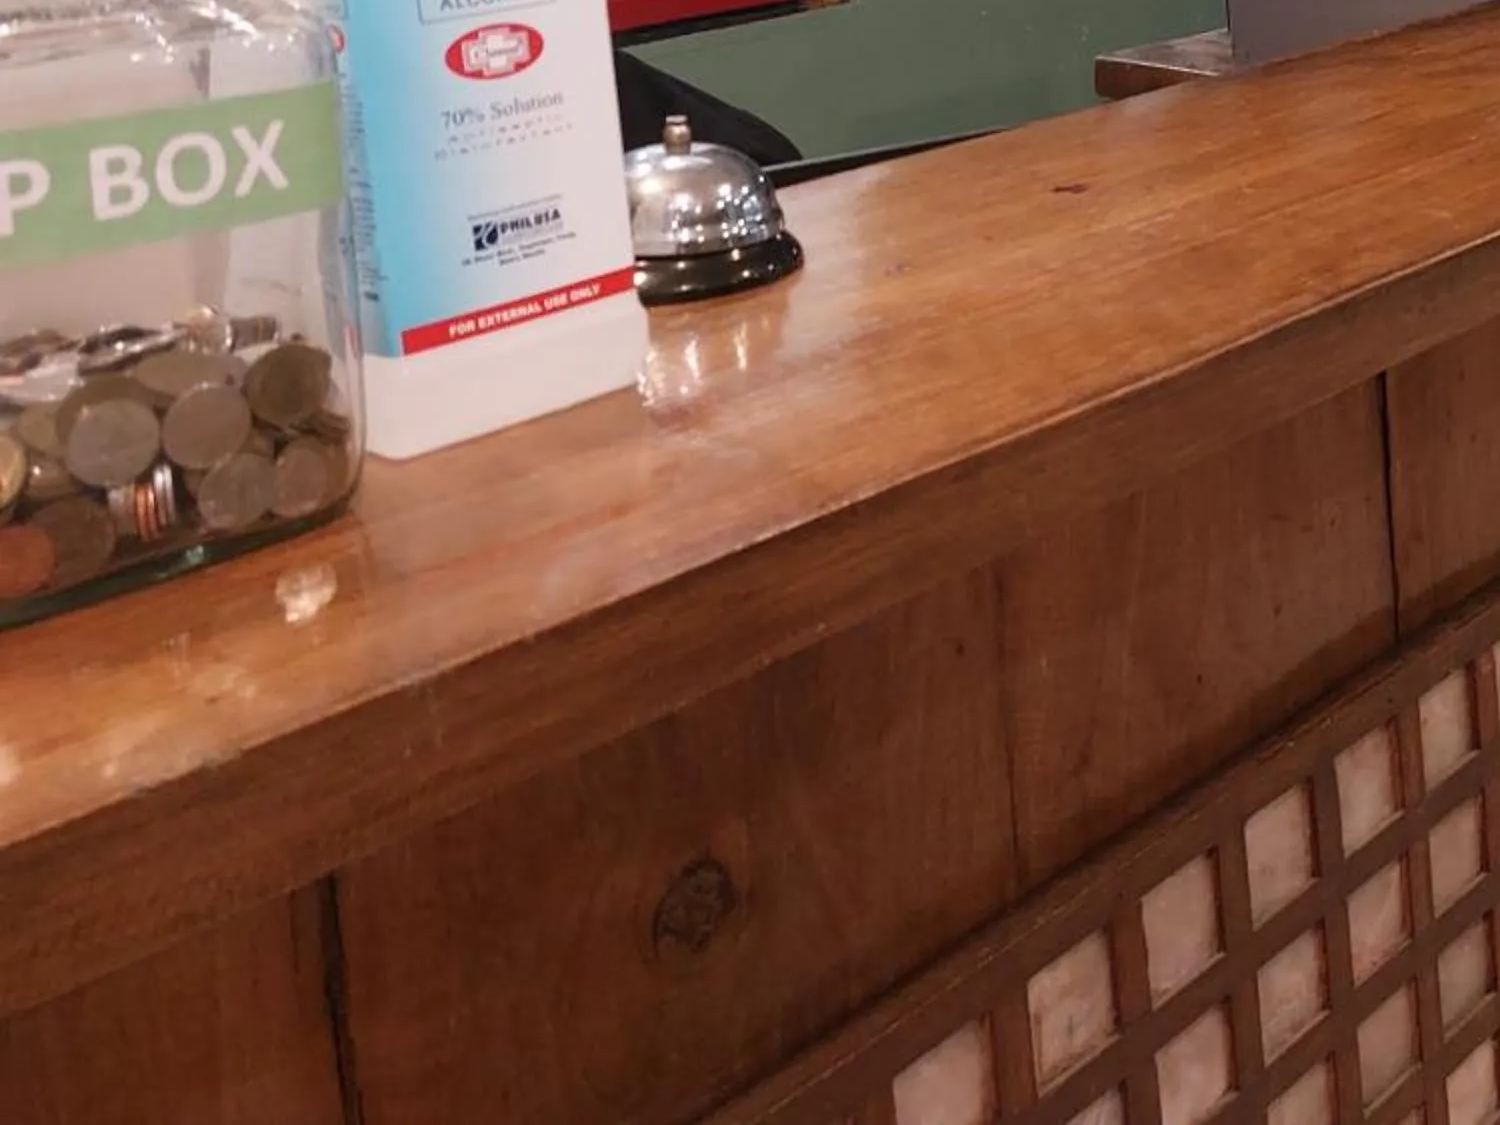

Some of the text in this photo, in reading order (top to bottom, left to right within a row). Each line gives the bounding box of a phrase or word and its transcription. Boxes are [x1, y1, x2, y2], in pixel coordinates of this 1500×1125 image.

[440, 107, 486, 129] 70%
[490, 92, 564, 119] Solution
[89, 120, 289, 221] BOX
[448, 283, 601, 338] FOR EXTERNAL USE ONLY
